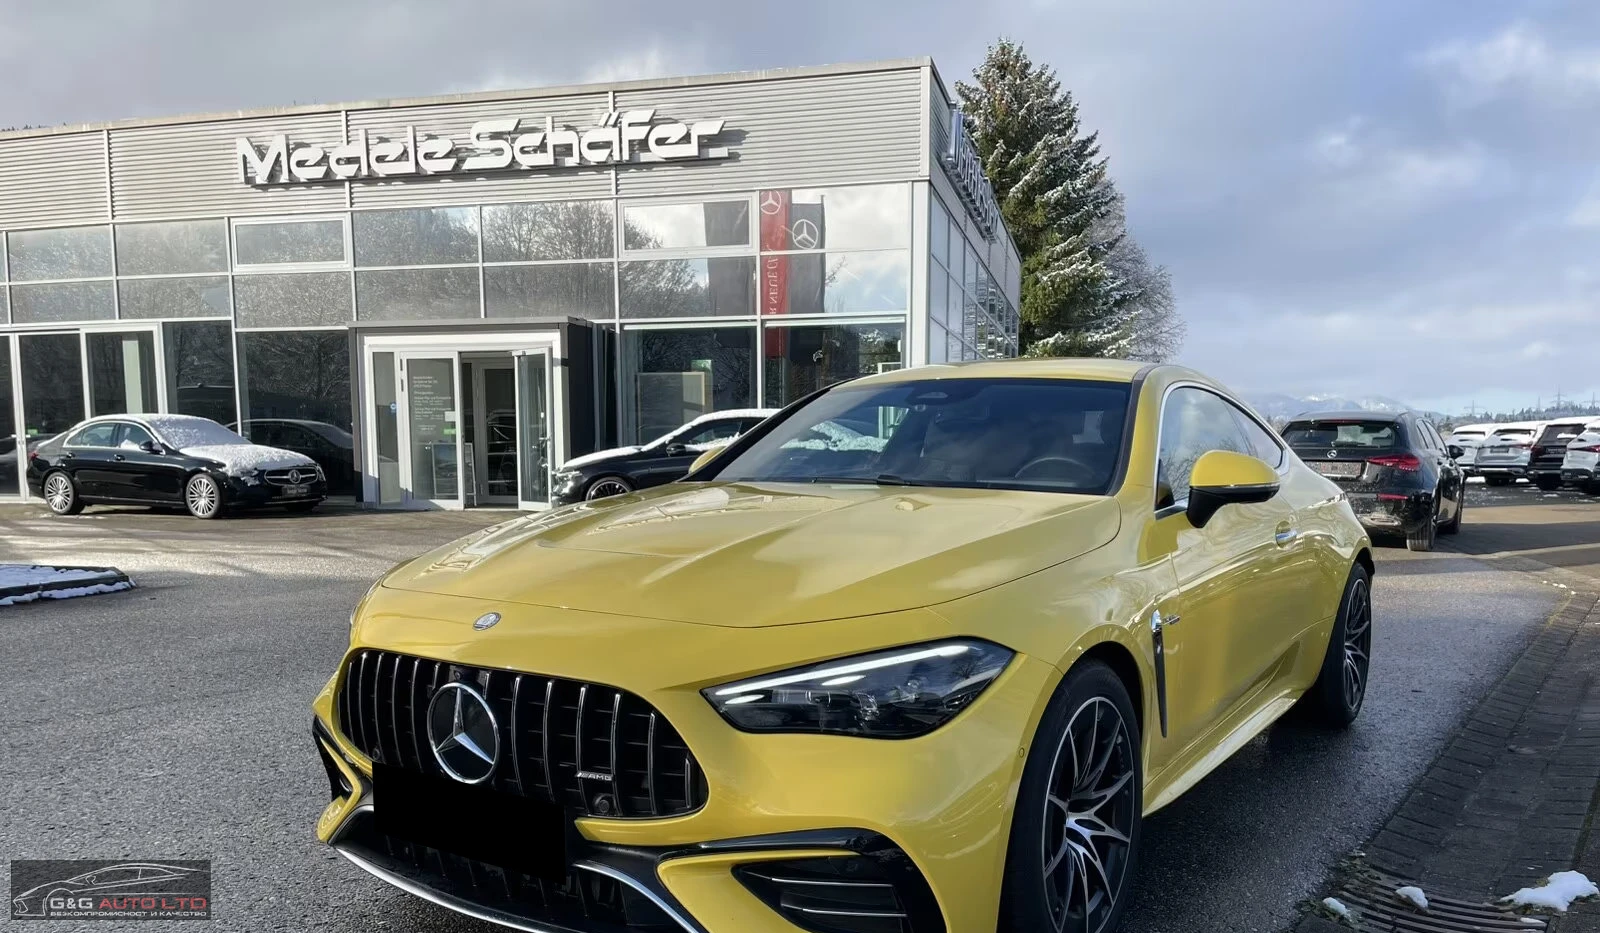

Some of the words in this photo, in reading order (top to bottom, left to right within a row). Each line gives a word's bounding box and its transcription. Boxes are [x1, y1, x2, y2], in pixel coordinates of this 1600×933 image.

[236, 126, 457, 184] Medele
[462, 109, 725, 170] Schäfer
[586, 773, 612, 781] AMG
